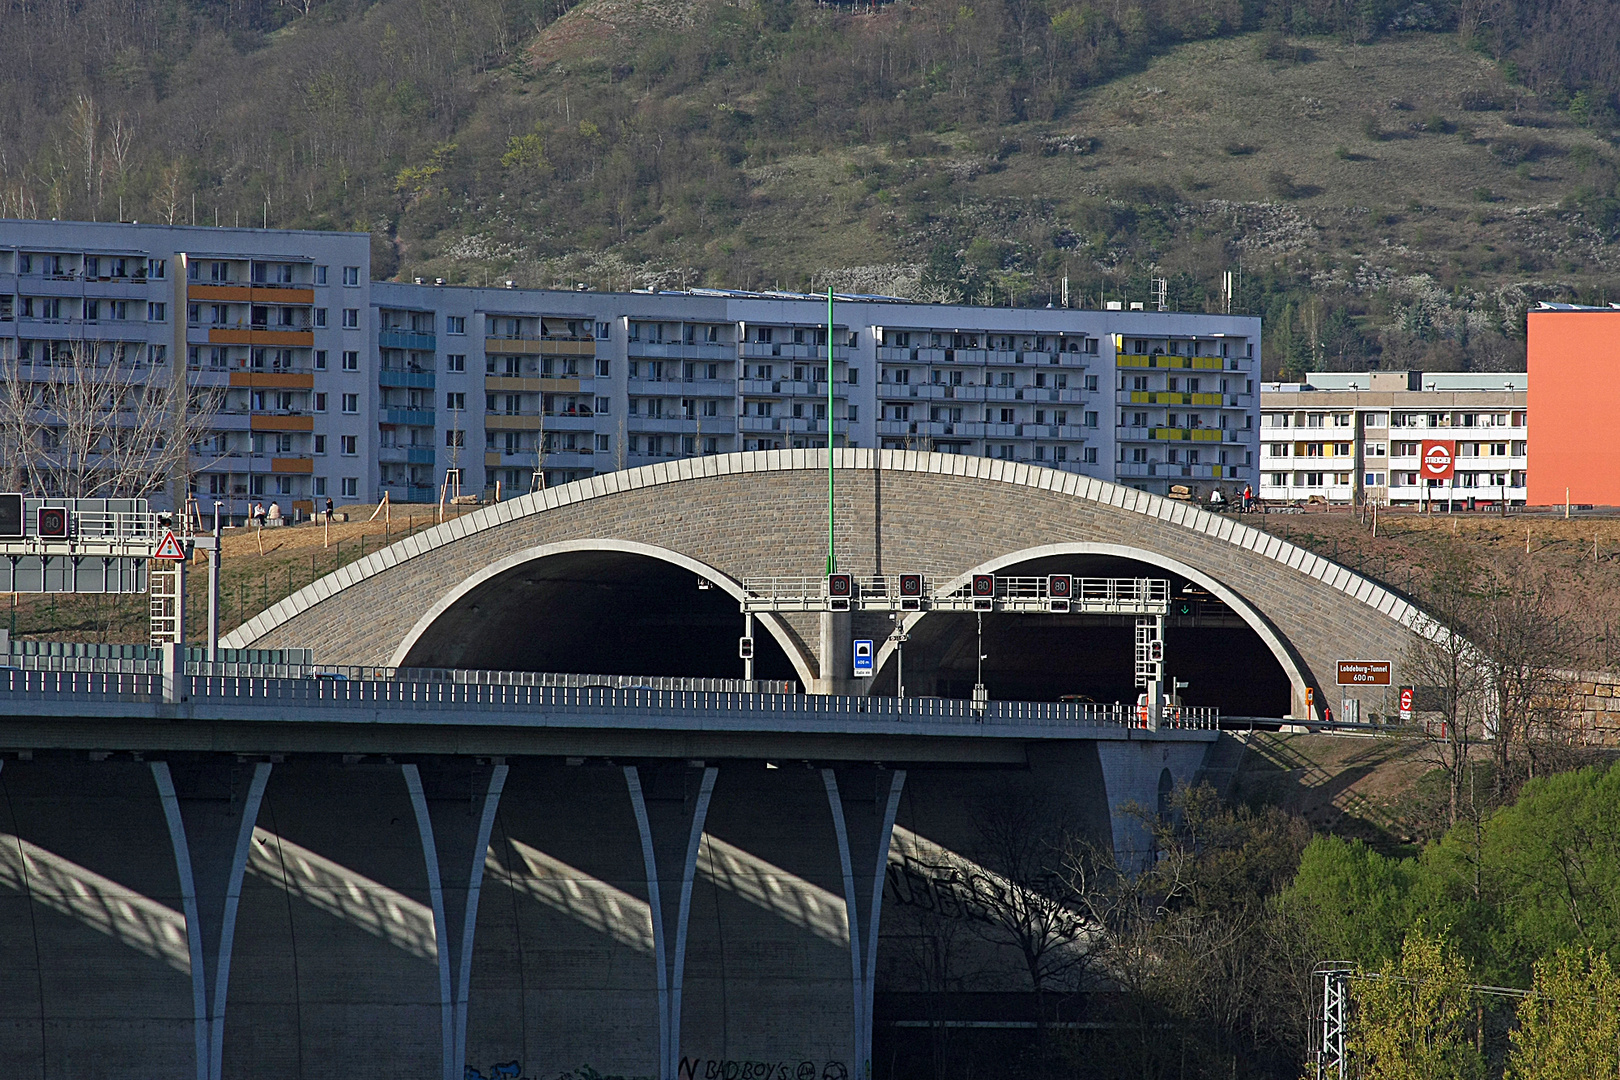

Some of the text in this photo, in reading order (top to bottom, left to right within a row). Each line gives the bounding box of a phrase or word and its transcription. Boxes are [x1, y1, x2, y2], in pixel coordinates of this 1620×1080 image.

[45, 516, 59, 528] 80
[834, 580, 846, 591] 80
[905, 580, 916, 591] 80
[977, 580, 989, 591] 80
[1054, 581, 1066, 592] 80
[1340, 664, 1388, 674] Lobdeburg-Tunnel
[1353, 674, 1367, 682] 600
